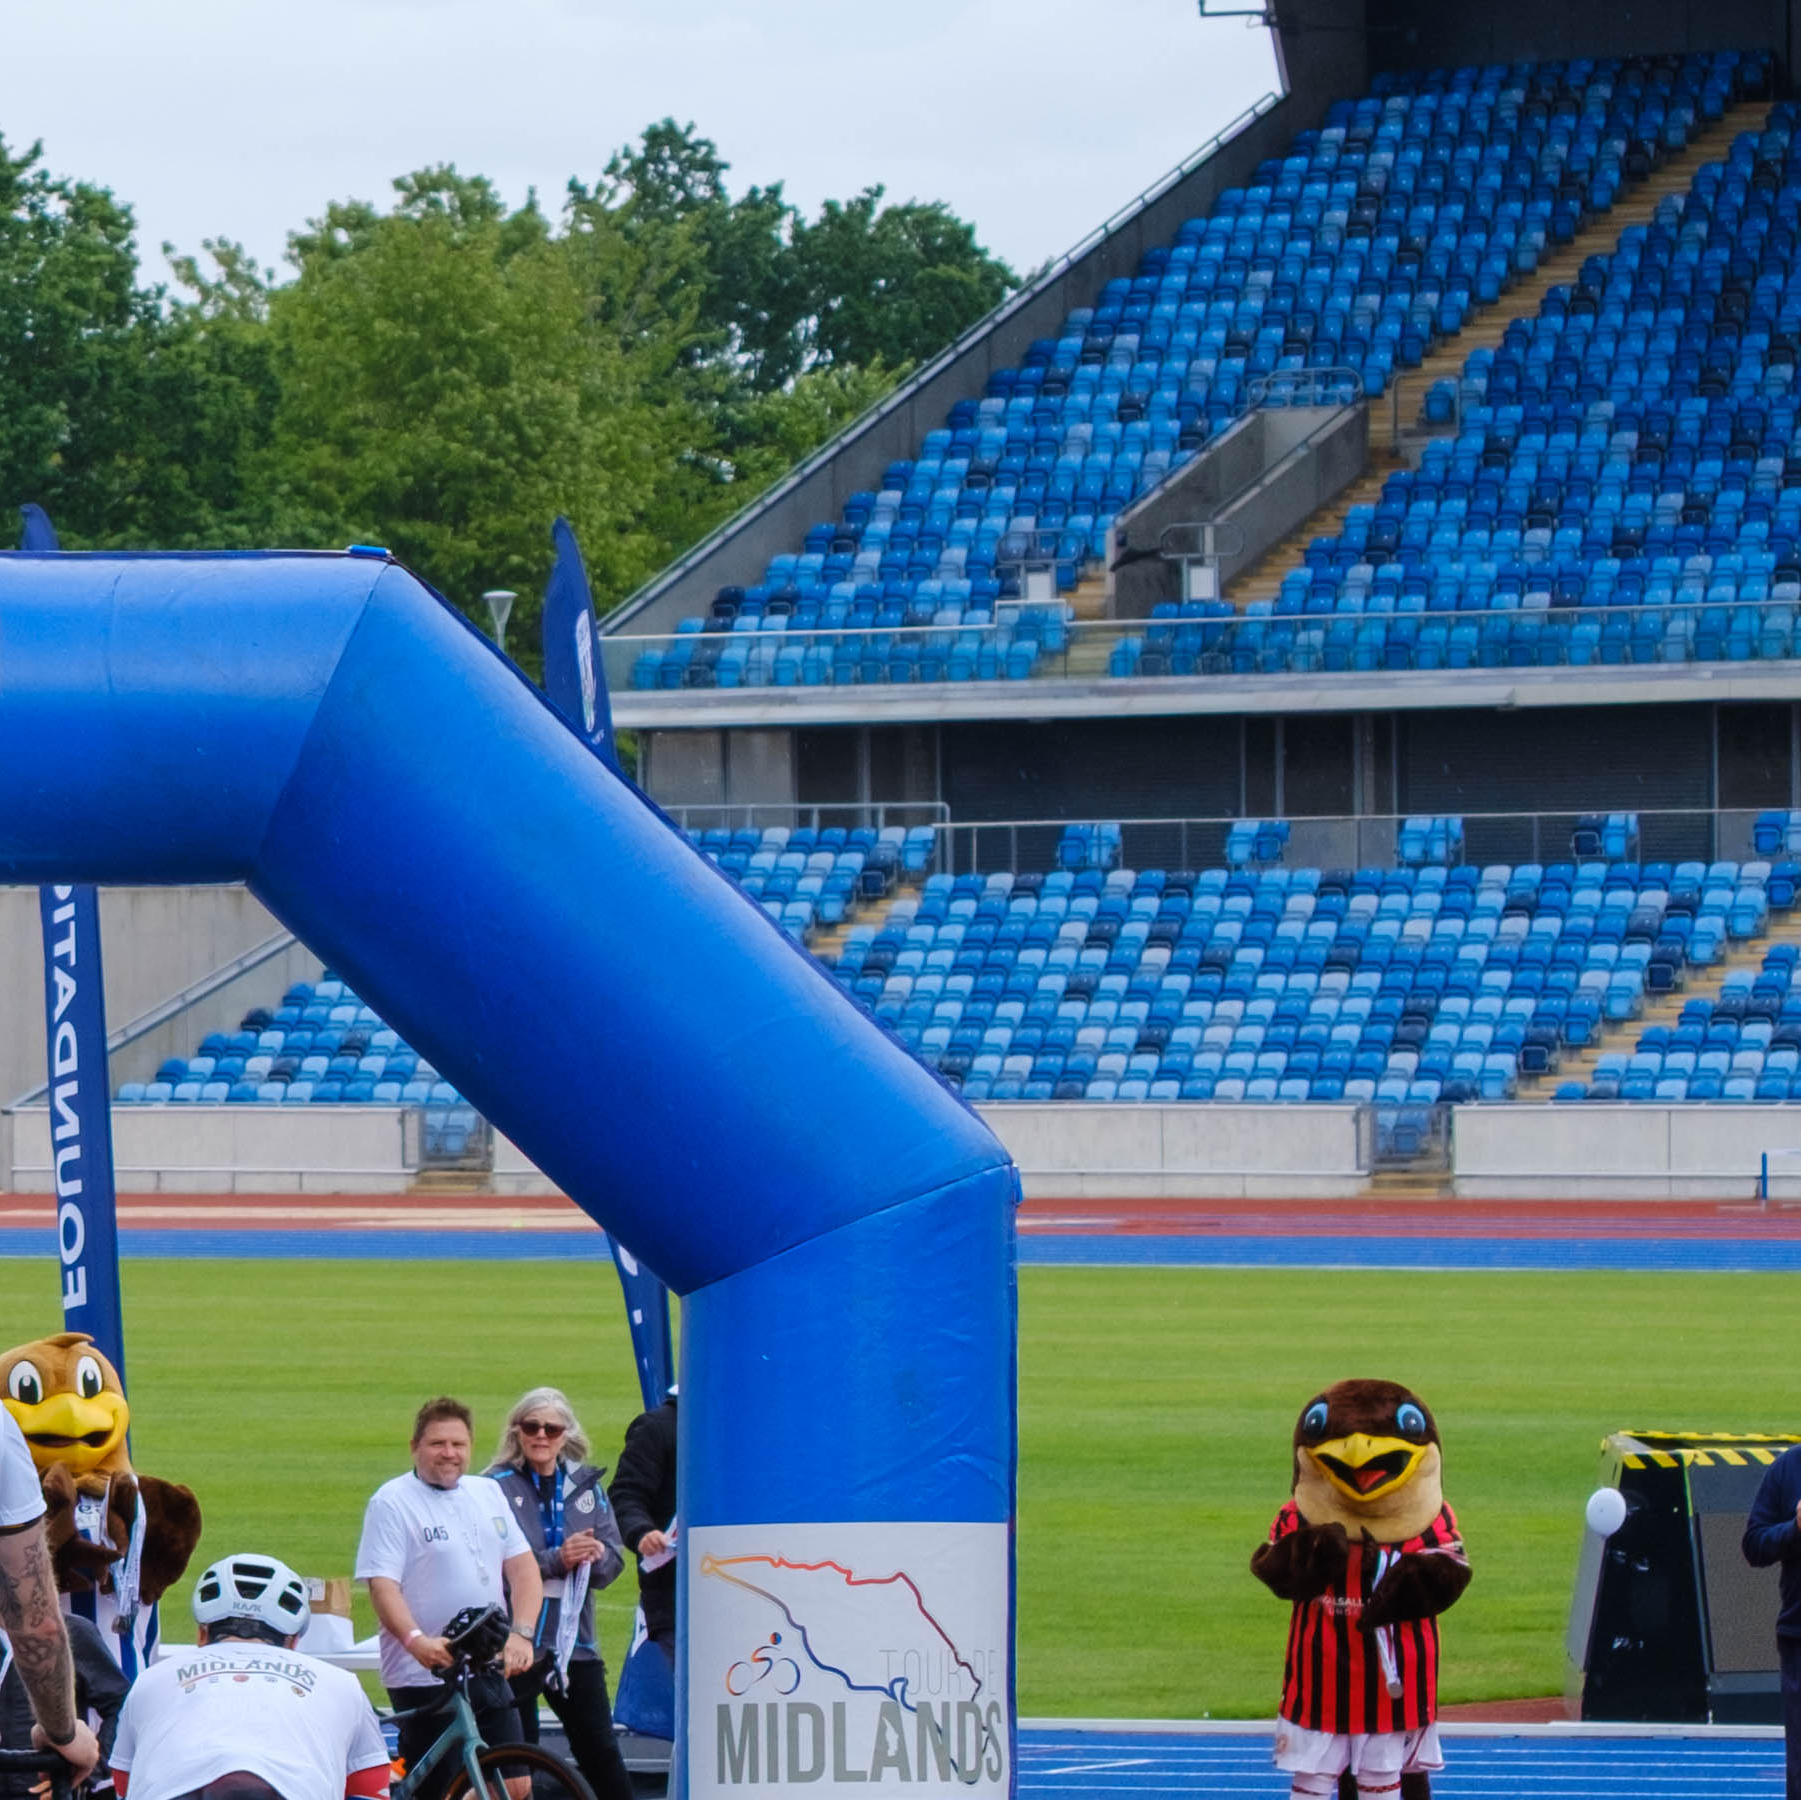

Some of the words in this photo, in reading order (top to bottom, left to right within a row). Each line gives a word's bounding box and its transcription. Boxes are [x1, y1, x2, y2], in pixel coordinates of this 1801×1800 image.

[424, 1526, 449, 1542] 045
[176, 1660, 318, 1687] MIDLANDS
[879, 1650, 963, 1696] TOUR
[717, 1700, 1002, 1784] MIDLANDS
